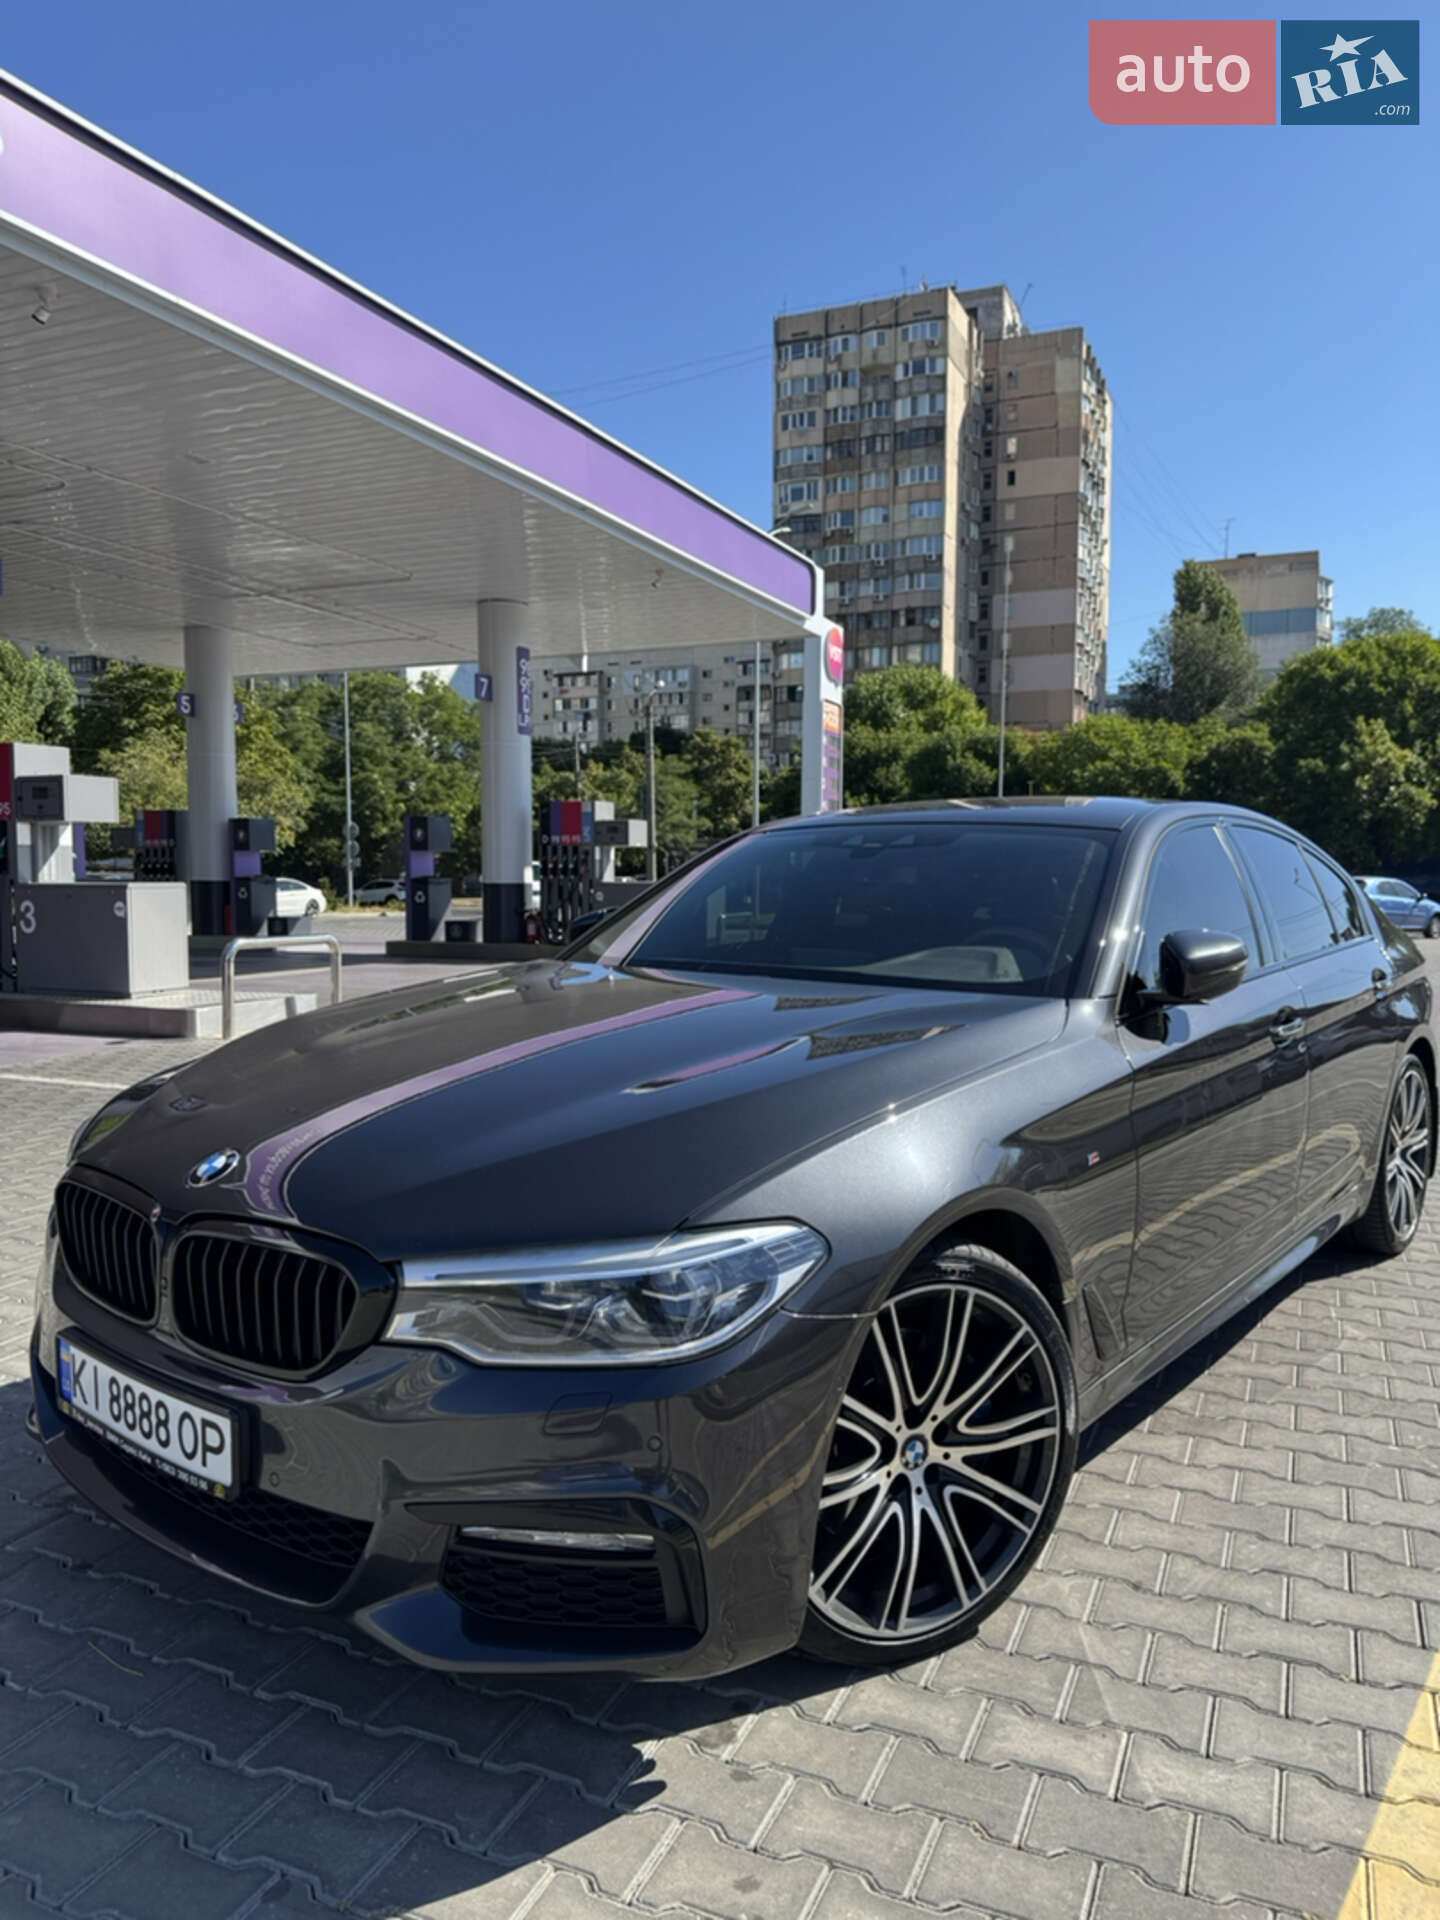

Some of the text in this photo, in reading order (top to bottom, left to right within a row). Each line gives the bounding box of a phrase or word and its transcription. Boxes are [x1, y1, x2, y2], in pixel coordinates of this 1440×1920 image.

[479, 676, 489, 698] 7
[180, 695, 191, 714] 5
[20, 900, 36, 934] 3
[72, 1353, 99, 1411] KI
[108, 1375, 171, 1449] 8888
[177, 1410, 226, 1468] OP
